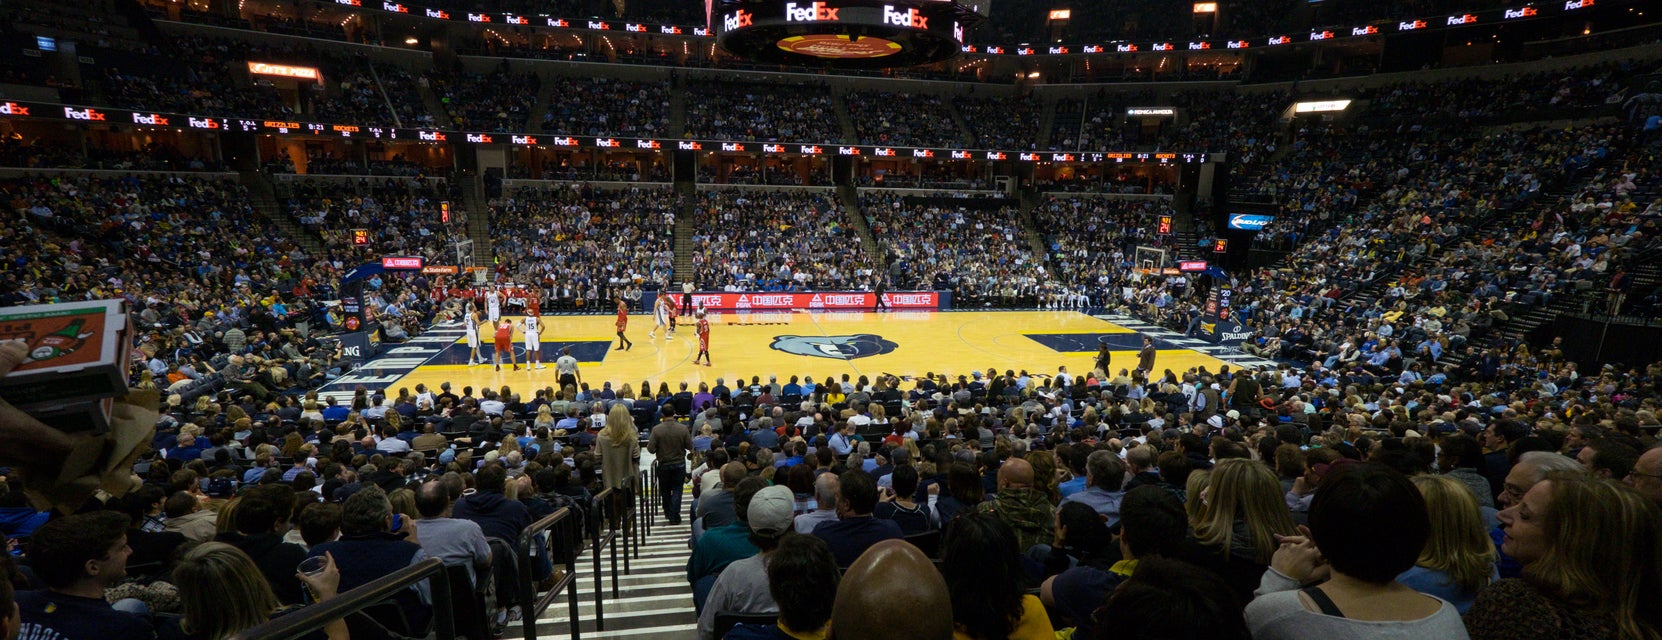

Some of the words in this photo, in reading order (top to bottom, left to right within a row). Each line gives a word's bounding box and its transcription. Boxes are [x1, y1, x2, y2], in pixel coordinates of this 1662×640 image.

[384, 2, 408, 13] FedEx
[786, 2, 839, 21] FedEx
[427, 9, 449, 19] FedEx
[883, 5, 928, 29] FedEx
[1505, 8, 1537, 18] FedEx
[468, 14, 490, 22] FedEx
[507, 16, 528, 24] FedEx
[724, 9, 752, 32] FedEx
[1448, 15, 1477, 25] FedEx
[589, 21, 609, 29] FedEx
[1399, 20, 1427, 30] FedEx
[662, 26, 682, 34] FedEx
[694, 28, 714, 36] FedE
[1353, 26, 1378, 35] FedEx
[1310, 31, 1334, 40] FedEx
[1269, 36, 1291, 45] FedEx
[65, 107, 105, 121] FedEx
[133, 113, 169, 125] FedEx
[264, 121, 300, 129] GRIZZLIES
[333, 125, 360, 133] ROCKETS
[420, 131, 447, 140] FedEx
[467, 134, 493, 142] FedEx
[512, 136, 537, 144] FedEx
[555, 137, 579, 145] FedEx
[596, 138, 620, 147] FedEx
[638, 140, 661, 148] FedEx
[679, 142, 702, 150] FedEx
[722, 143, 745, 151] FedEx
[763, 144, 785, 152] FedEx
[801, 146, 823, 154] FedEx
[840, 147, 861, 155] FedEx
[875, 148, 896, 156] FedEx
[914, 149, 934, 157] FedEx
[987, 152, 1007, 160] FedEx
[1053, 154, 1075, 162] FedEx
[1160, 223, 1169, 232] 24
[355, 236, 366, 244] 24
[752, 295, 793, 306] 中国匹克
[825, 294, 865, 306] 中国匹克
[893, 294, 931, 305] 中国匹克
